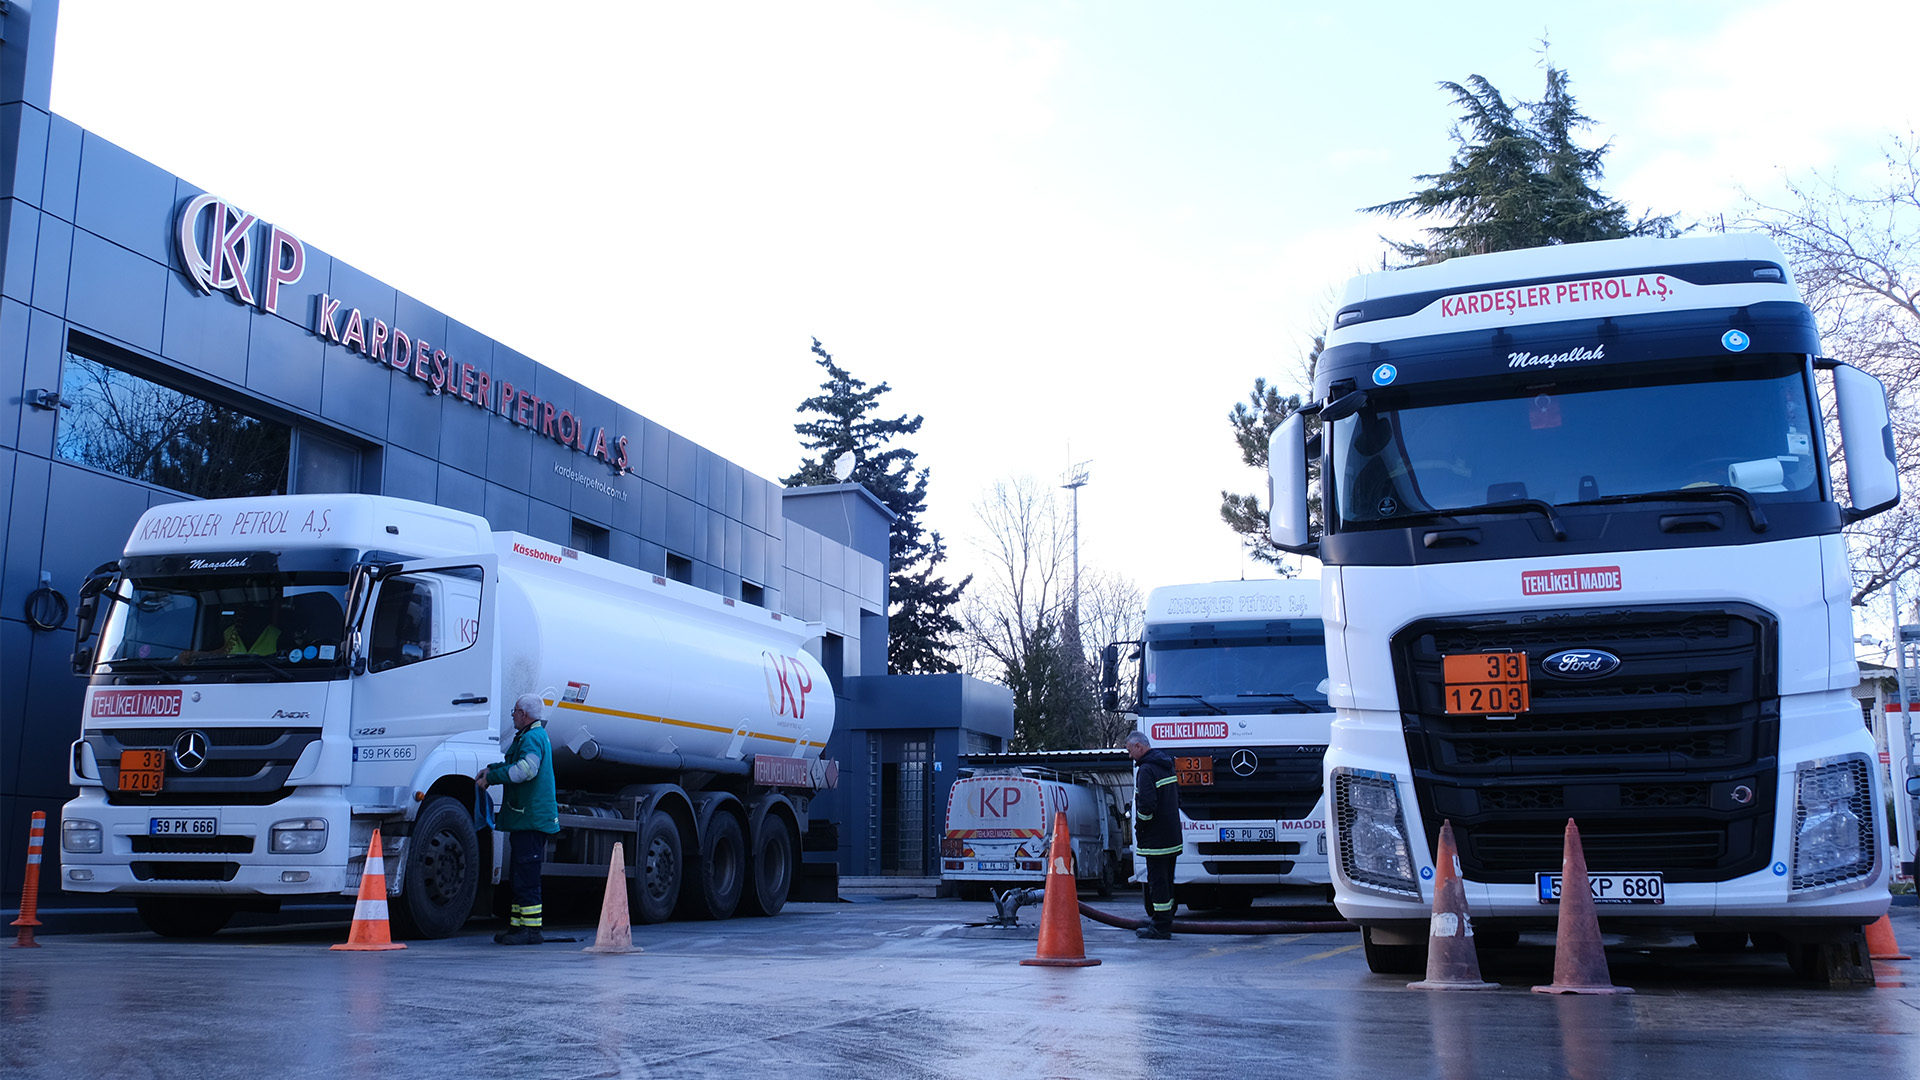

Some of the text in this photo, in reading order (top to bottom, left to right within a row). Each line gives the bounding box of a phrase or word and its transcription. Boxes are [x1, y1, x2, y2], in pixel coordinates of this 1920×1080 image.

[210, 199, 306, 314] KP
[1441, 275, 1674, 318] KARDEŞLER PETROL A.Ş.
[1507, 344, 1605, 369] Maaşallah
[320, 293, 635, 476] KARDEŞLER PETROL A.Ş.
[139, 508, 332, 544] KARDEŞLER PETROL A.Ş.
[189, 557, 249, 571] Maaşallah
[1523, 571, 1621, 593] TEHLİKELİ MADDE
[1487, 655, 1520, 679] 33
[1558, 653, 1602, 672] Ford
[94, 694, 181, 715] TEHLİKELİ MADDE
[1451, 687, 1522, 711] 1203
[354, 727, 387, 737] 3229
[1155, 722, 1226, 739] TEHLİKELİ MADDE
[143, 752, 162, 769] 33
[362, 749, 375, 760] 59
[377, 748, 391, 759] PK
[393, 747, 412, 759] 666
[1185, 758, 1200, 770] 33
[122, 773, 161, 790] 1203
[1179, 772, 1210, 784] 1203
[980, 786, 1022, 818] KP
[156, 820, 213, 833] 59 PK 666
[1225, 829, 1274, 839] 59 PU 205
[1551, 877, 1661, 898] 5 KP 680
